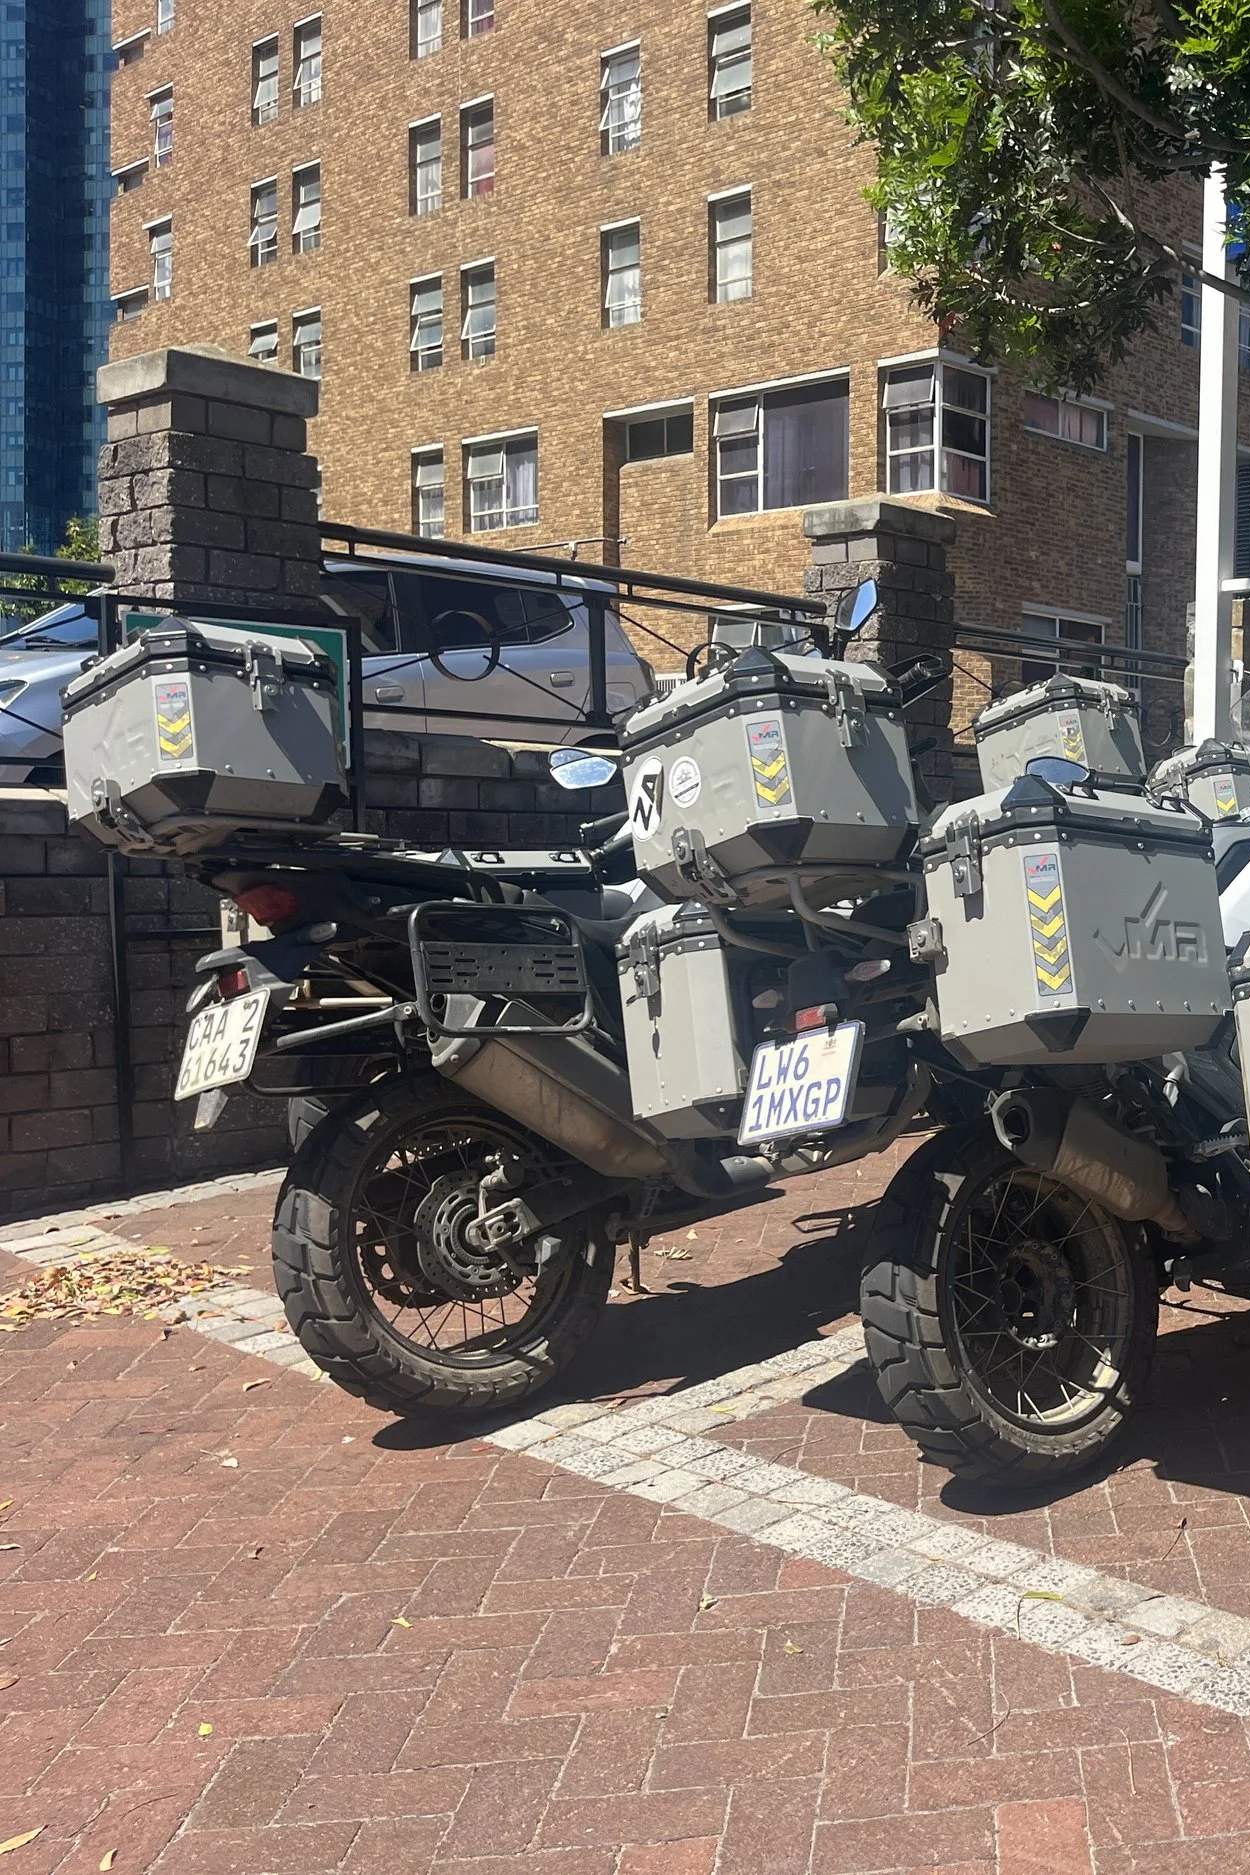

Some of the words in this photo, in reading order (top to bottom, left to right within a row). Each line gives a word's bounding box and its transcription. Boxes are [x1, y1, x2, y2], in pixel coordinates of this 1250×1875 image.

[189, 1009, 229, 1051] CAA
[242, 998, 260, 1033] 2
[179, 1036, 251, 1091] 61643
[756, 1044, 810, 1090] LW6
[748, 1077, 842, 1132] 1MXGP
